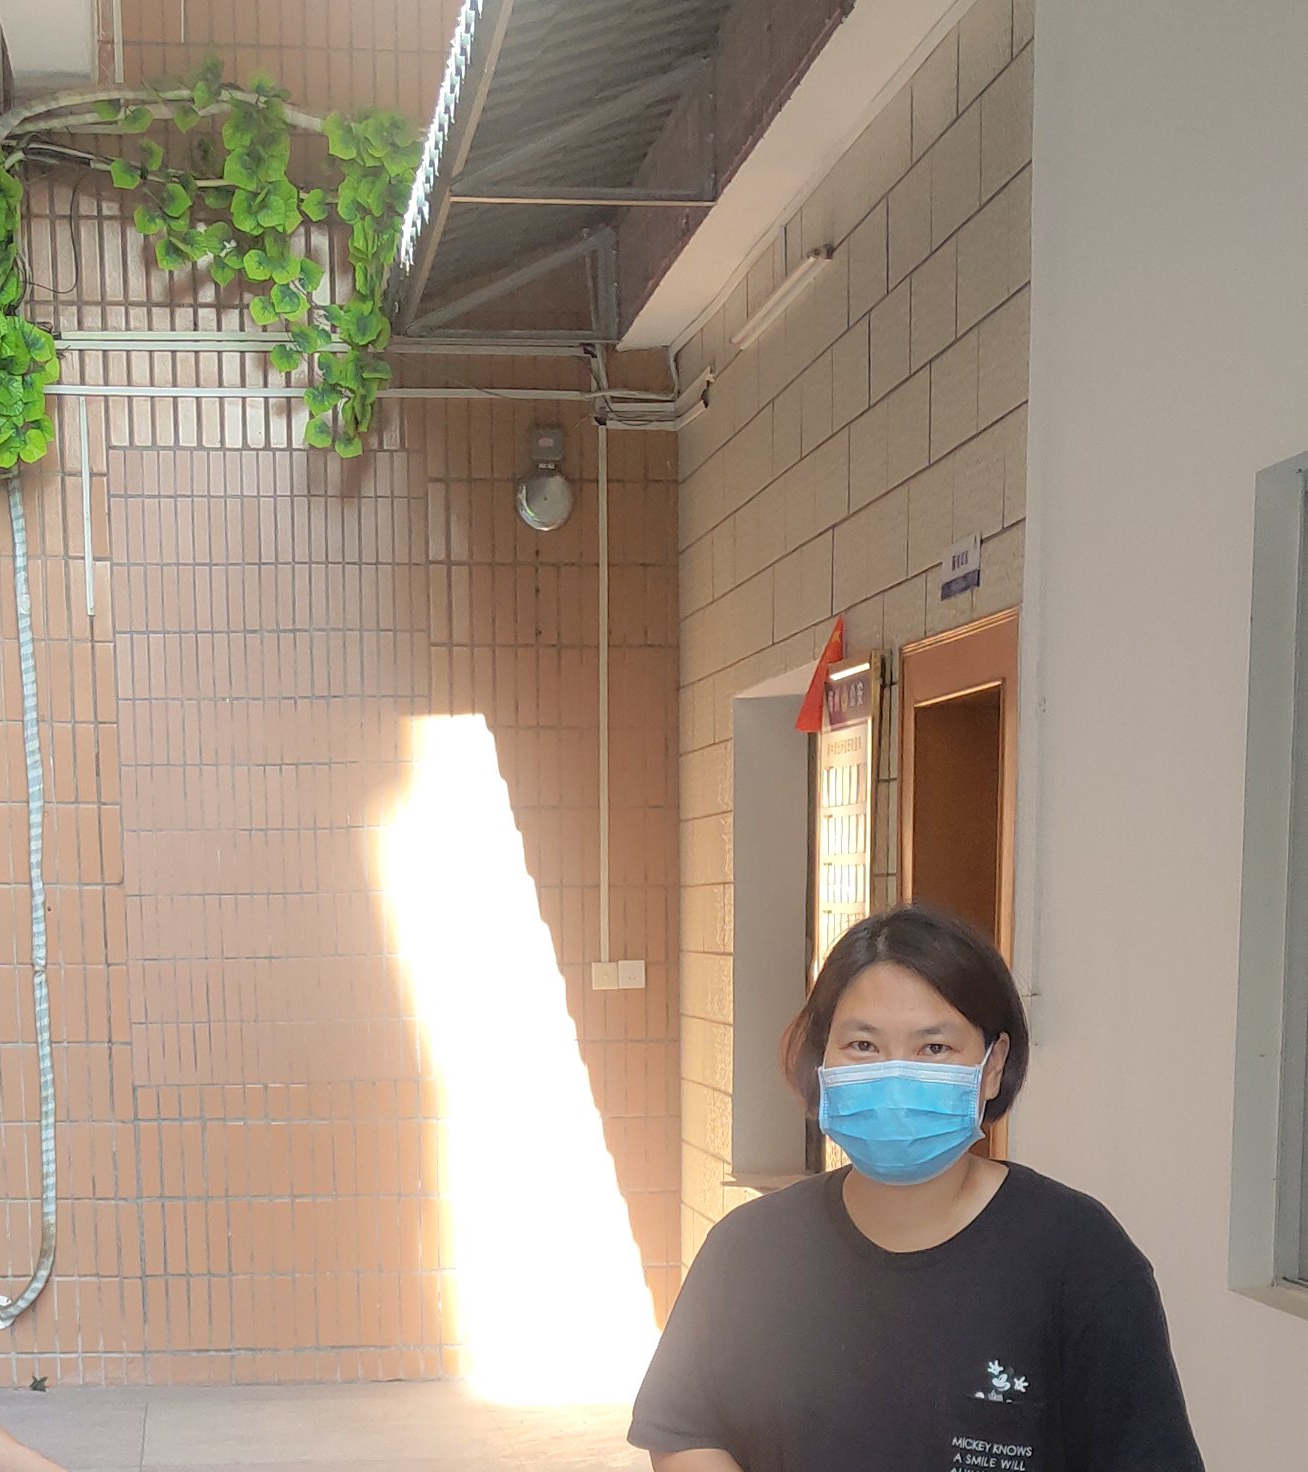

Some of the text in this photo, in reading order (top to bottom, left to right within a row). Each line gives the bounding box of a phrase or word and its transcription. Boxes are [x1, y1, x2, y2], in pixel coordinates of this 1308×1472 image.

[952, 1436, 1032, 1457] MICKEY KNOWS
[953, 1453, 1026, 1471] A SMILE WILL
